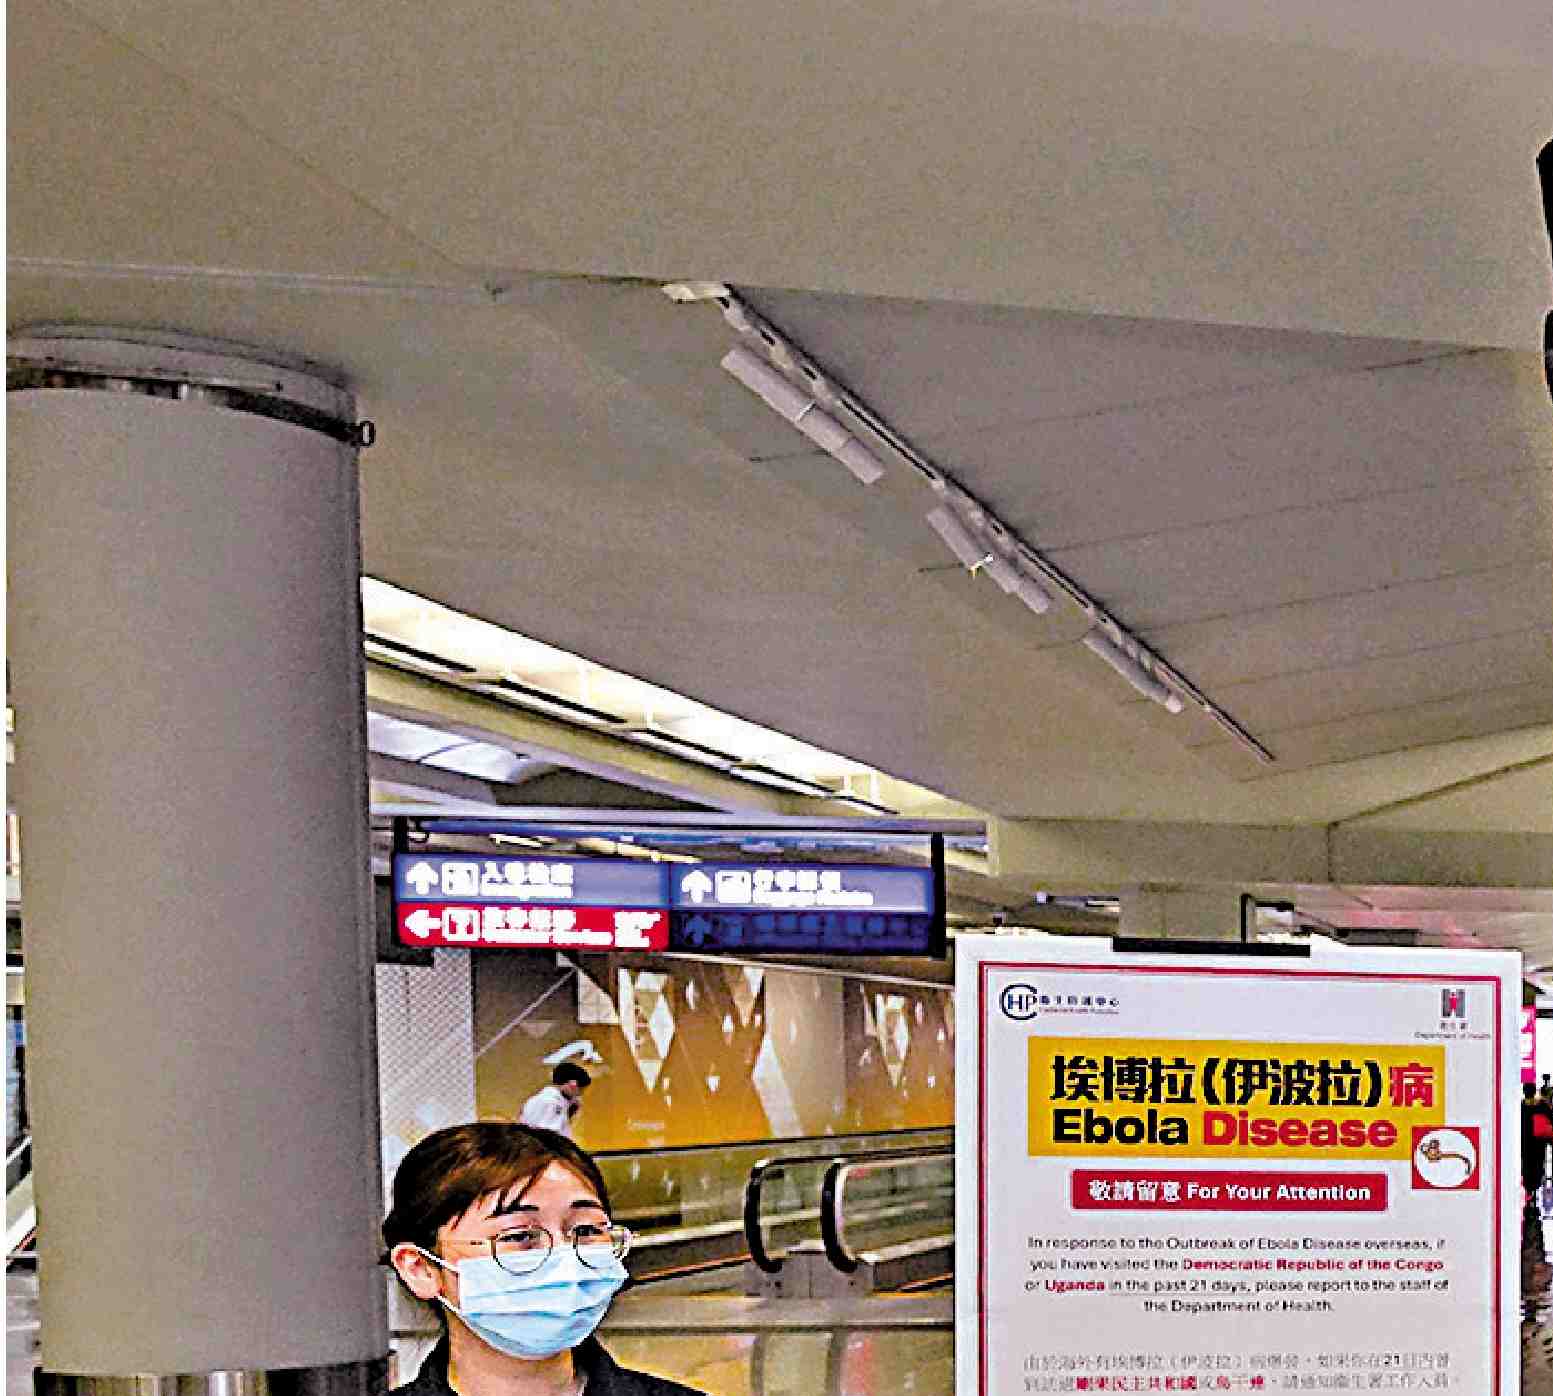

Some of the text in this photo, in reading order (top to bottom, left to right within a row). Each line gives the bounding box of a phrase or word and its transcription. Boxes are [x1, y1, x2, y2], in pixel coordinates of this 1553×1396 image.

[1053, 1109, 1397, 1147] Ebola Disease
[1089, 1180, 1181, 1202] 敬請留意
[1187, 1184, 1371, 1201] For Your Attention
[1027, 1238, 1042, 1249] In
[1045, 1238, 1117, 1250] response
[1120, 1238, 1135, 1249] to
[1138, 1238, 1164, 1249] the
[1166, 1238, 1234, 1249] Outbreak
[1238, 1238, 1255, 1249] of
[1258, 1238, 1298, 1249] Ebola
[1303, 1238, 1360, 1250] Disease
[1364, 1239, 1432, 1252] overseas,
[1030, 1258, 1444, 1272] you have visited the Democratic Republic of the Congo
[1025, 1280, 1449, 1293] or Uganda in the past 21 days, please report to the staff of
[1144, 1300, 1334, 1313] the Department of Health.
